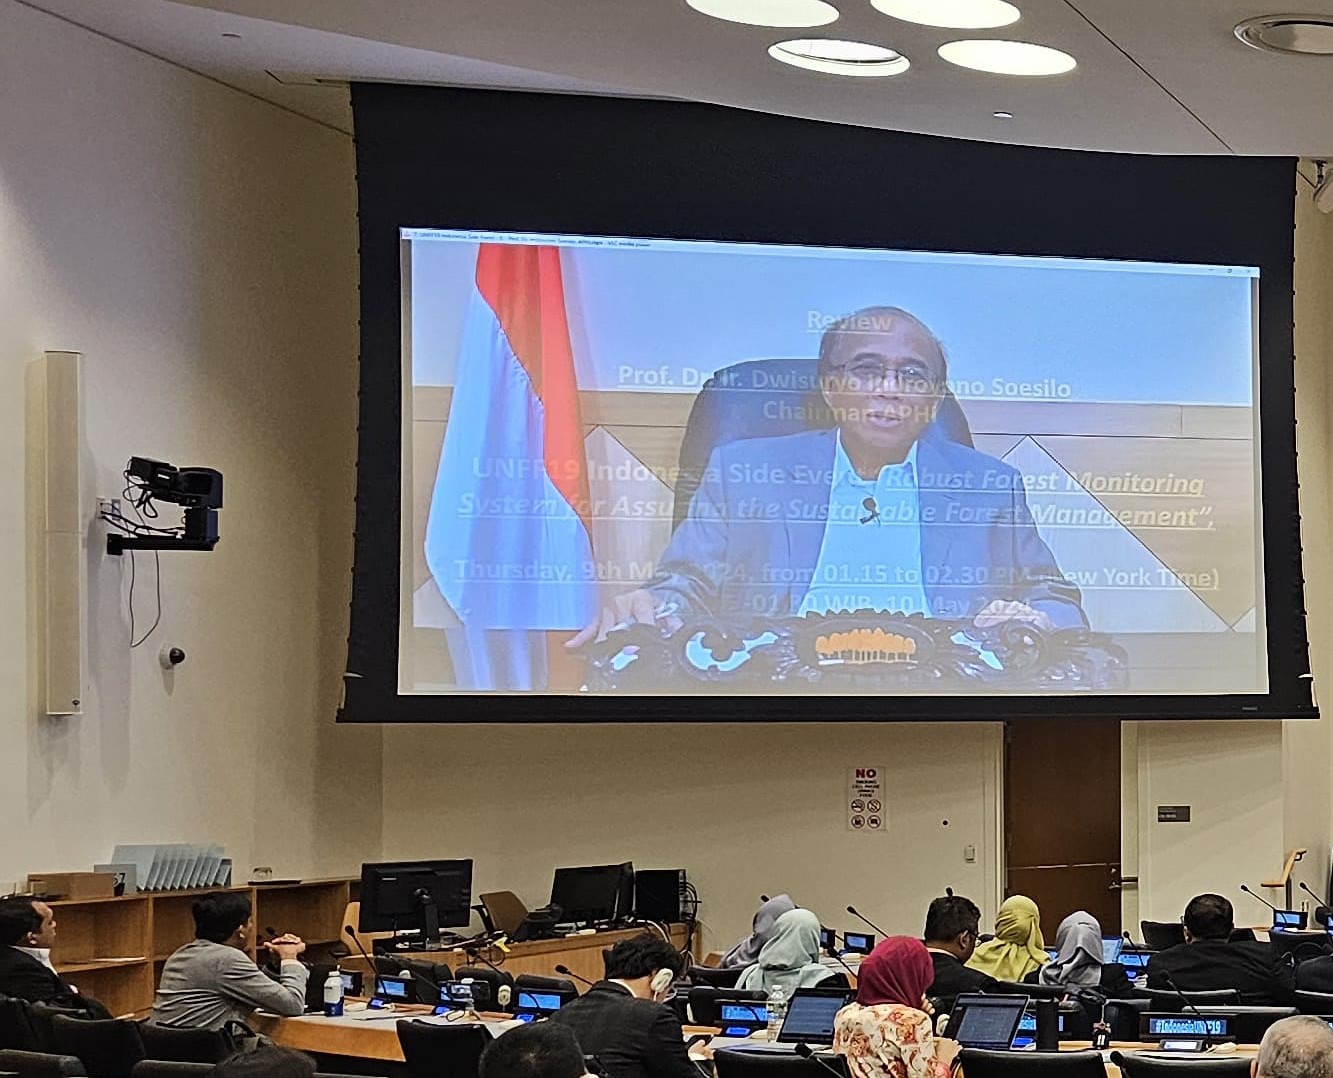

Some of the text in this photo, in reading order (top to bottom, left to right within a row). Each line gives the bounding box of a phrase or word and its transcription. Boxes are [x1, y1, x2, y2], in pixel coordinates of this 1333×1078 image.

[807, 311, 893, 332] Review
[618, 365, 675, 386] Prof.
[990, 379, 1073, 399] Soesilo
[588, 460, 722, 484] Indonea
[728, 463, 784, 485] Side
[982, 470, 1059, 491] Forest
[1066, 471, 1205, 496] Monitoring
[736, 498, 781, 519] the
[795, 500, 936, 524] Sustaable
[454, 559, 573, 584] Thursday,
[583, 561, 622, 581] 9th
[823, 565, 888, 584] 01.15
[895, 566, 919, 584] to
[927, 567, 990, 585] 02.30
[1102, 567, 1151, 587] York
[885, 594, 914, 612] 10
[855, 768, 877, 779] NO
